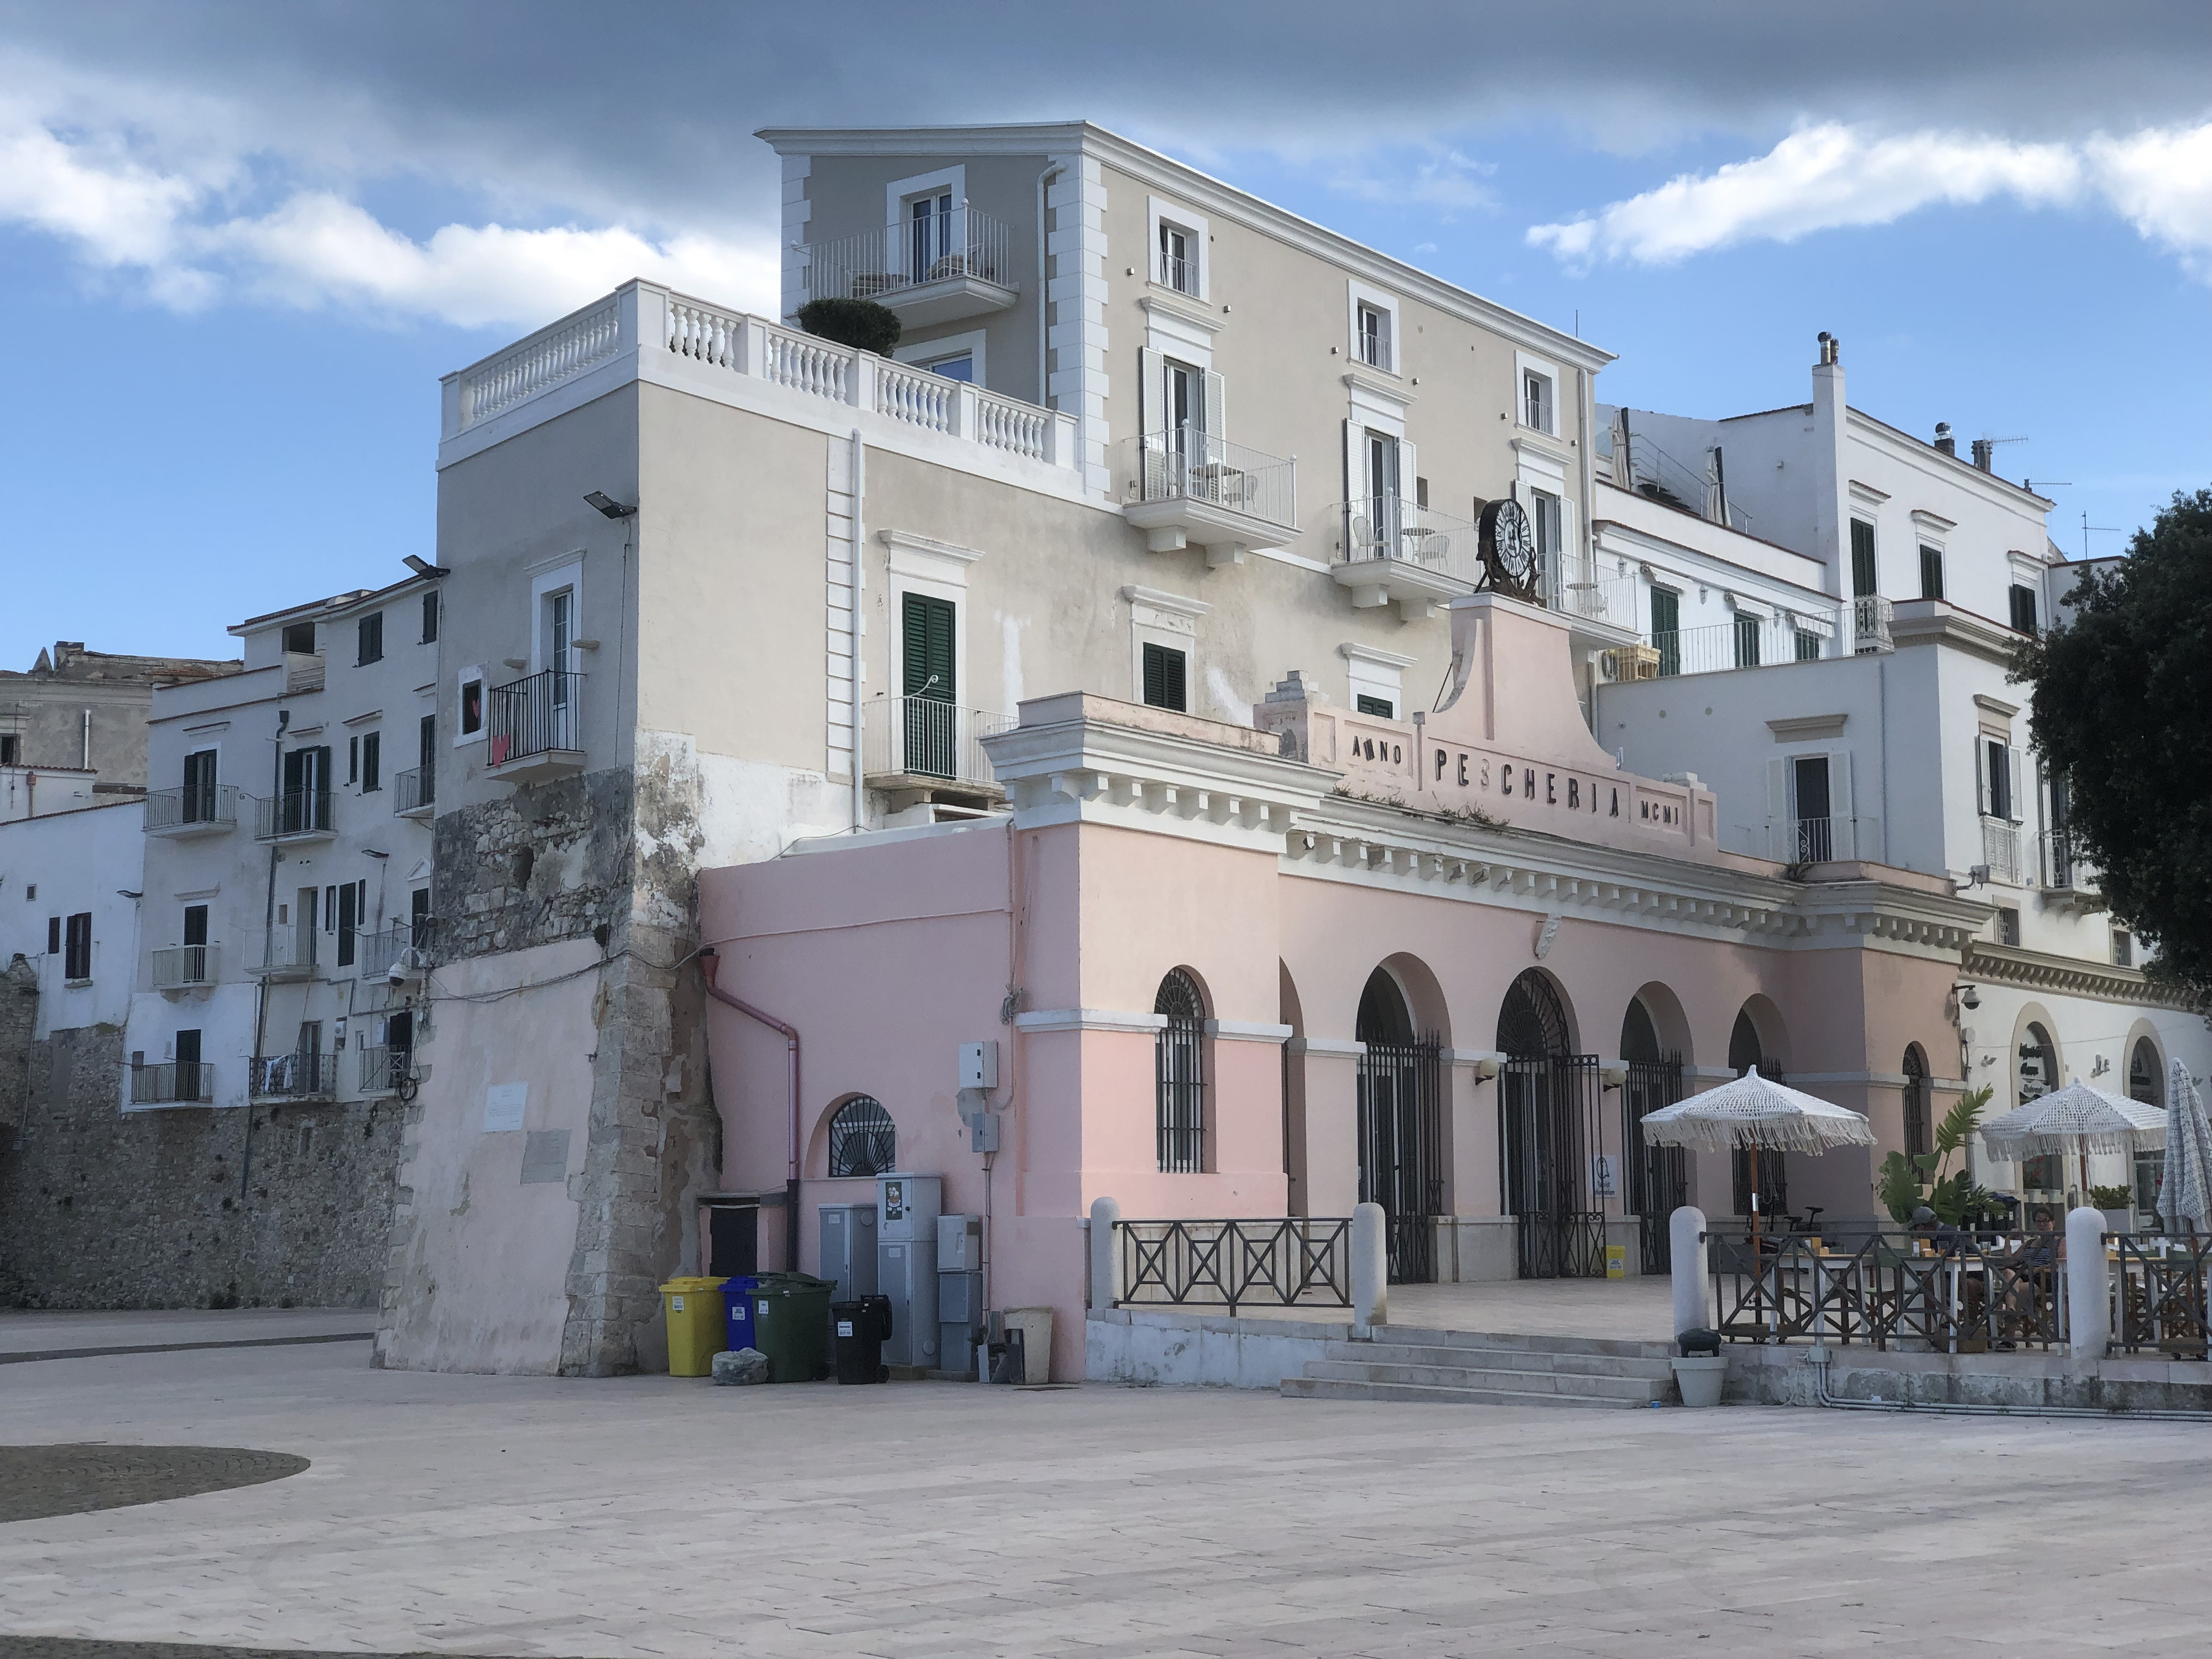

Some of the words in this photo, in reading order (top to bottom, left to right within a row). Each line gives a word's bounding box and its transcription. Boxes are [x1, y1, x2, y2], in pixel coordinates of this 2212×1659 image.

[1352, 735, 1401, 764] ANNO
[1434, 748, 1619, 817] PESCHERIA
[1640, 800, 1678, 825] MCMI
